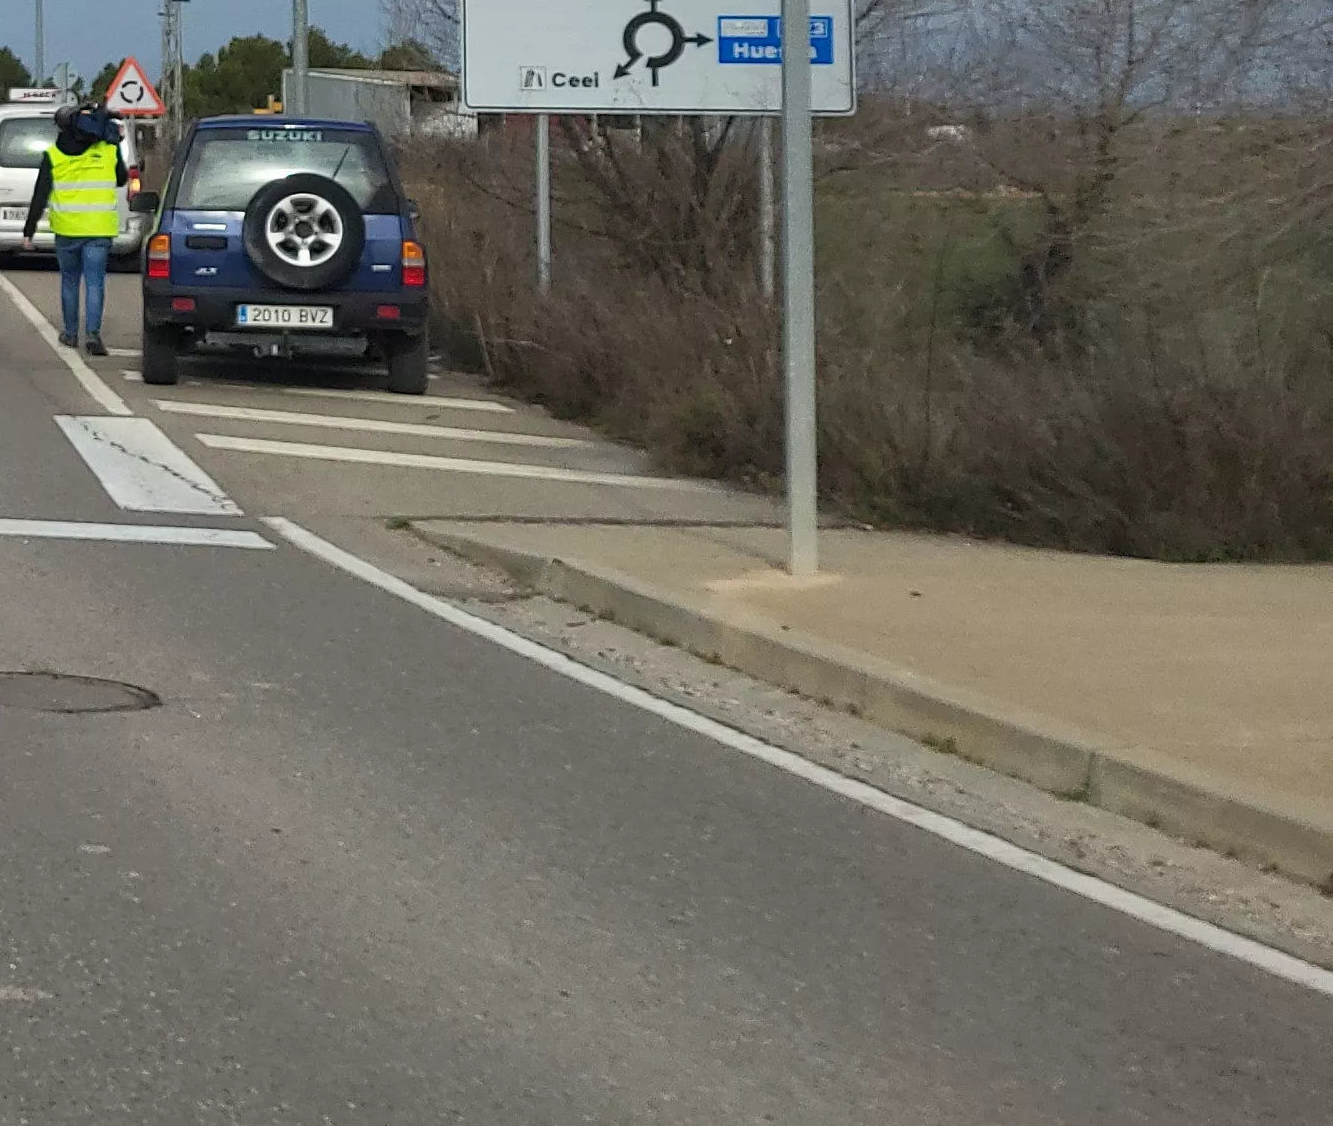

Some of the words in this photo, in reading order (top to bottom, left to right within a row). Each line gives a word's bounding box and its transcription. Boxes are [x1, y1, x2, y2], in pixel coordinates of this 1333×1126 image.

[733, 41, 818, 59] Huea
[246, 129, 323, 141] SUZUKI
[252, 308, 291, 323] 2010
[299, 308, 329, 324] BVZ
